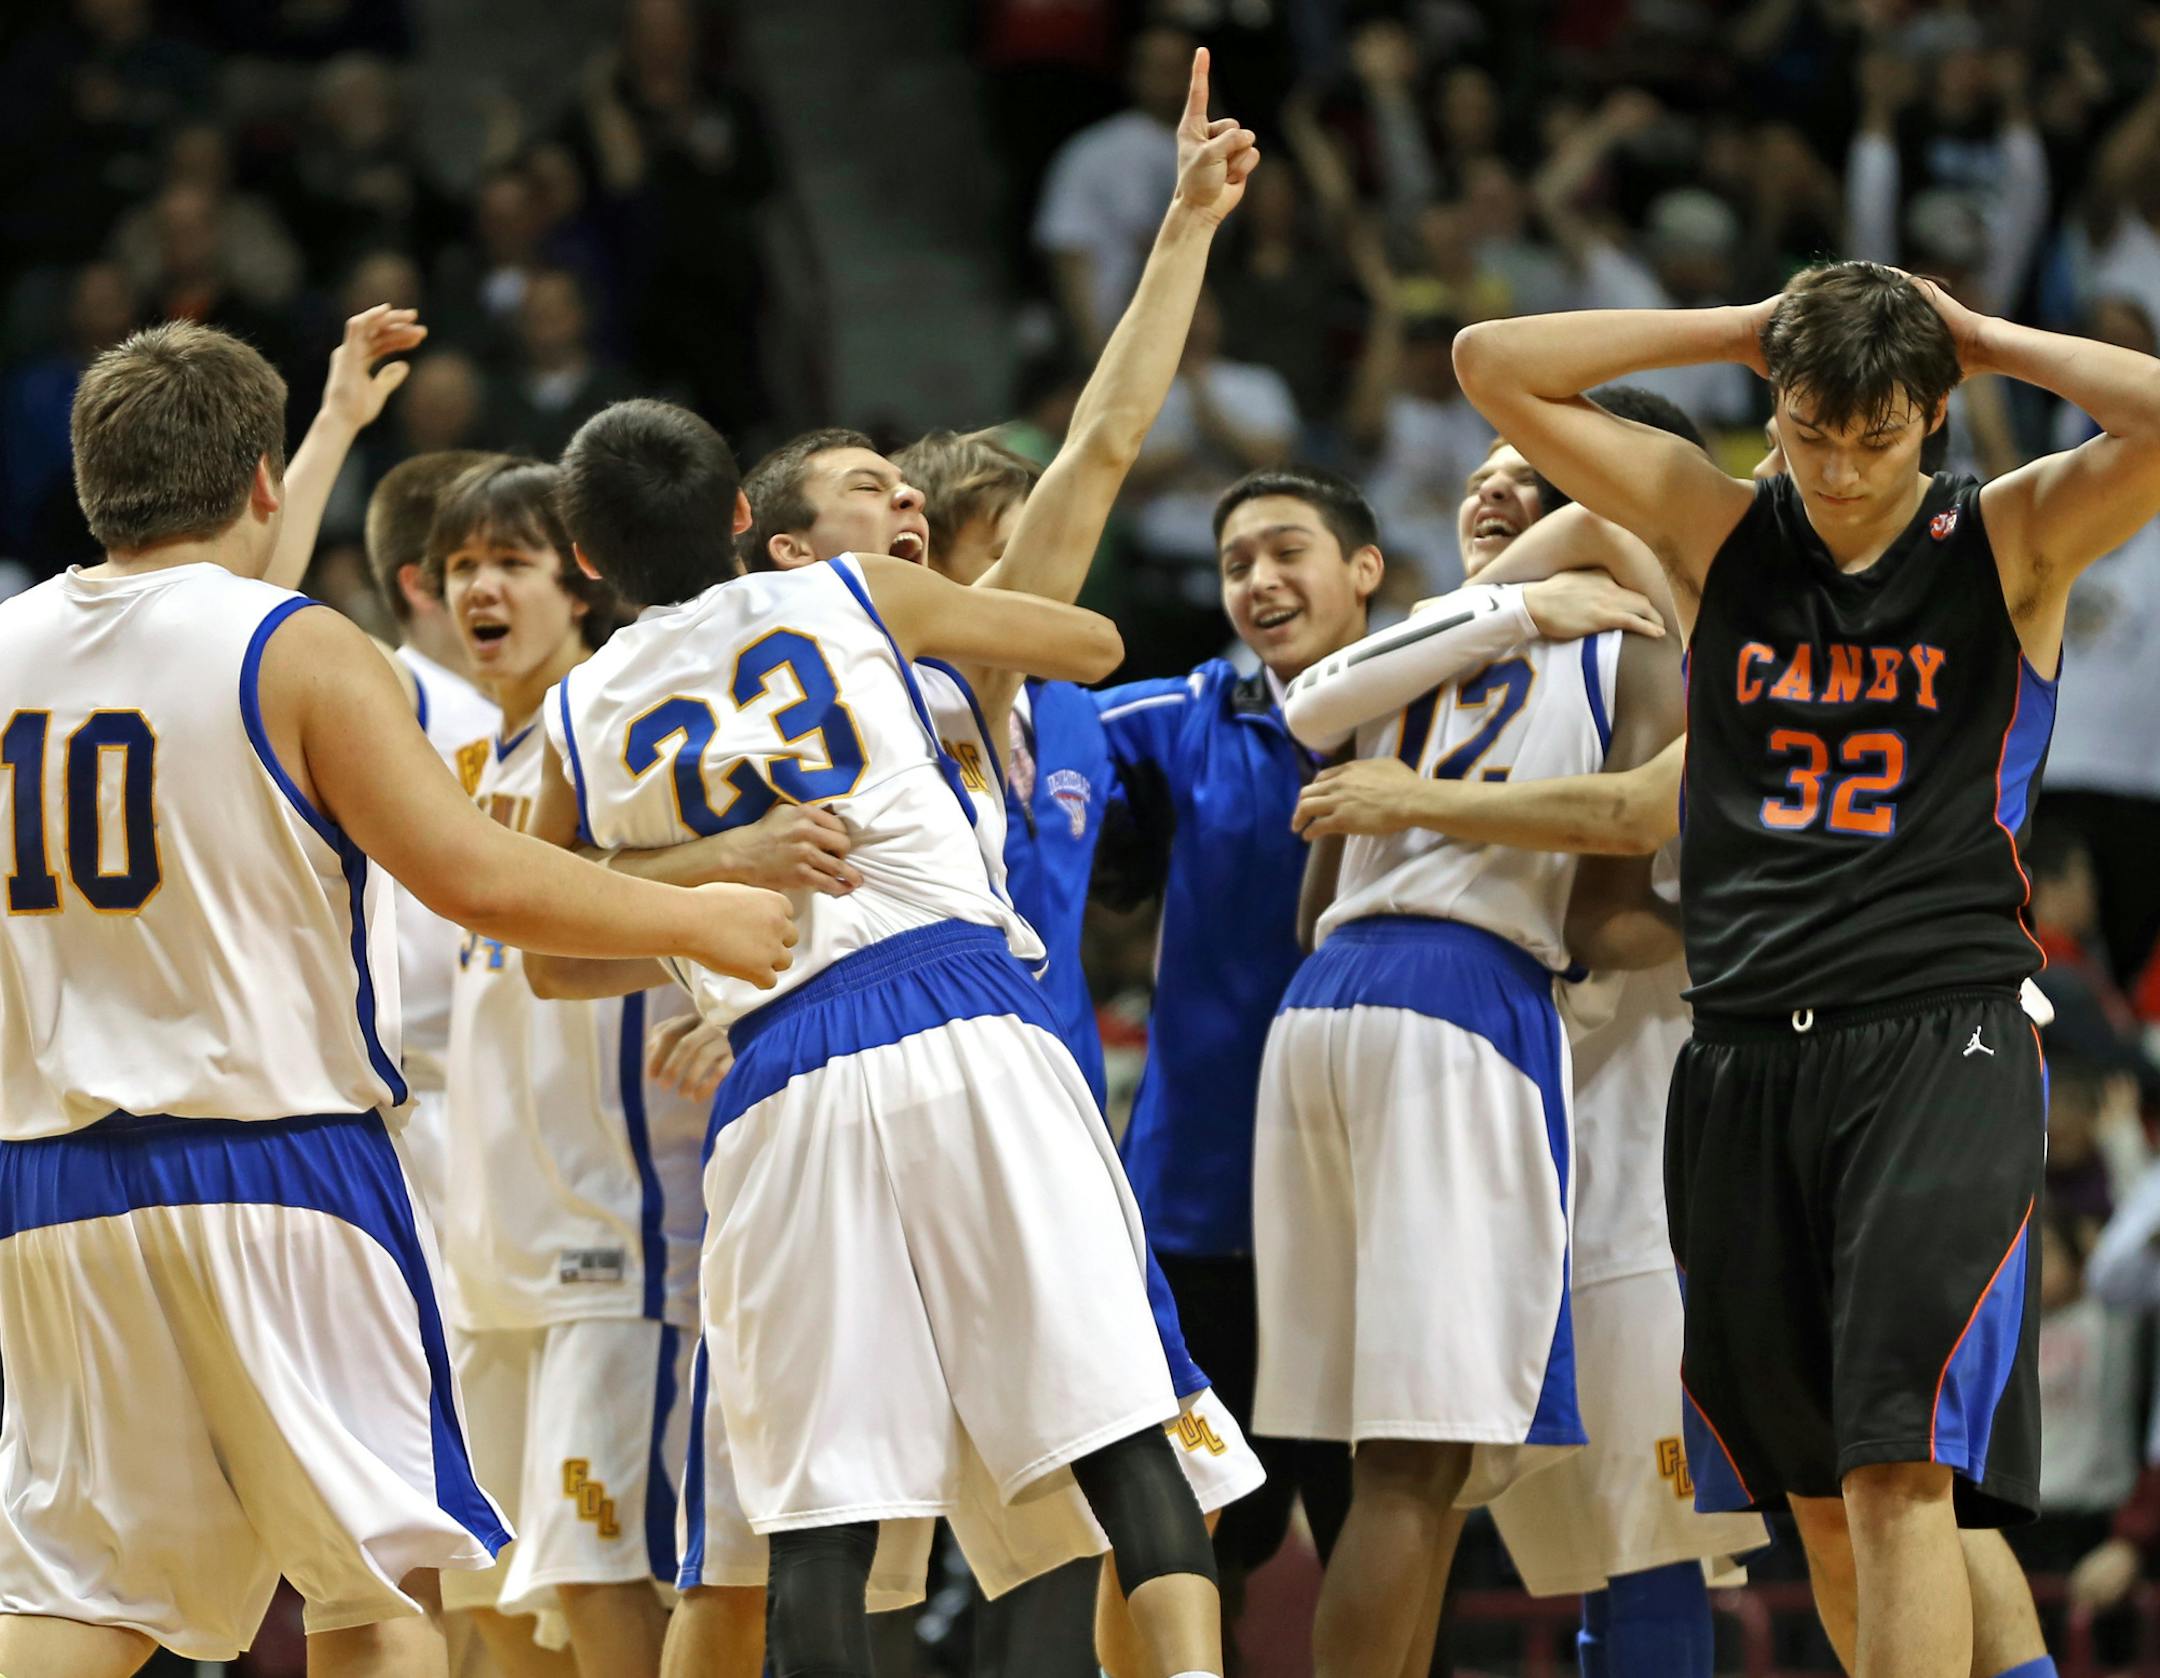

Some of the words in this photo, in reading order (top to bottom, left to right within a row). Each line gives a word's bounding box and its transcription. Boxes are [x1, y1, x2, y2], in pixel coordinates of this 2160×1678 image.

[1395, 656, 1537, 782] 12
[1737, 641, 1946, 710] CANBY
[620, 626, 871, 837] 23
[1759, 728, 1907, 838] 32
[0, 708, 163, 915] 10
[1164, 1407, 1228, 1456] DL
[562, 1457, 621, 1541] FDL
